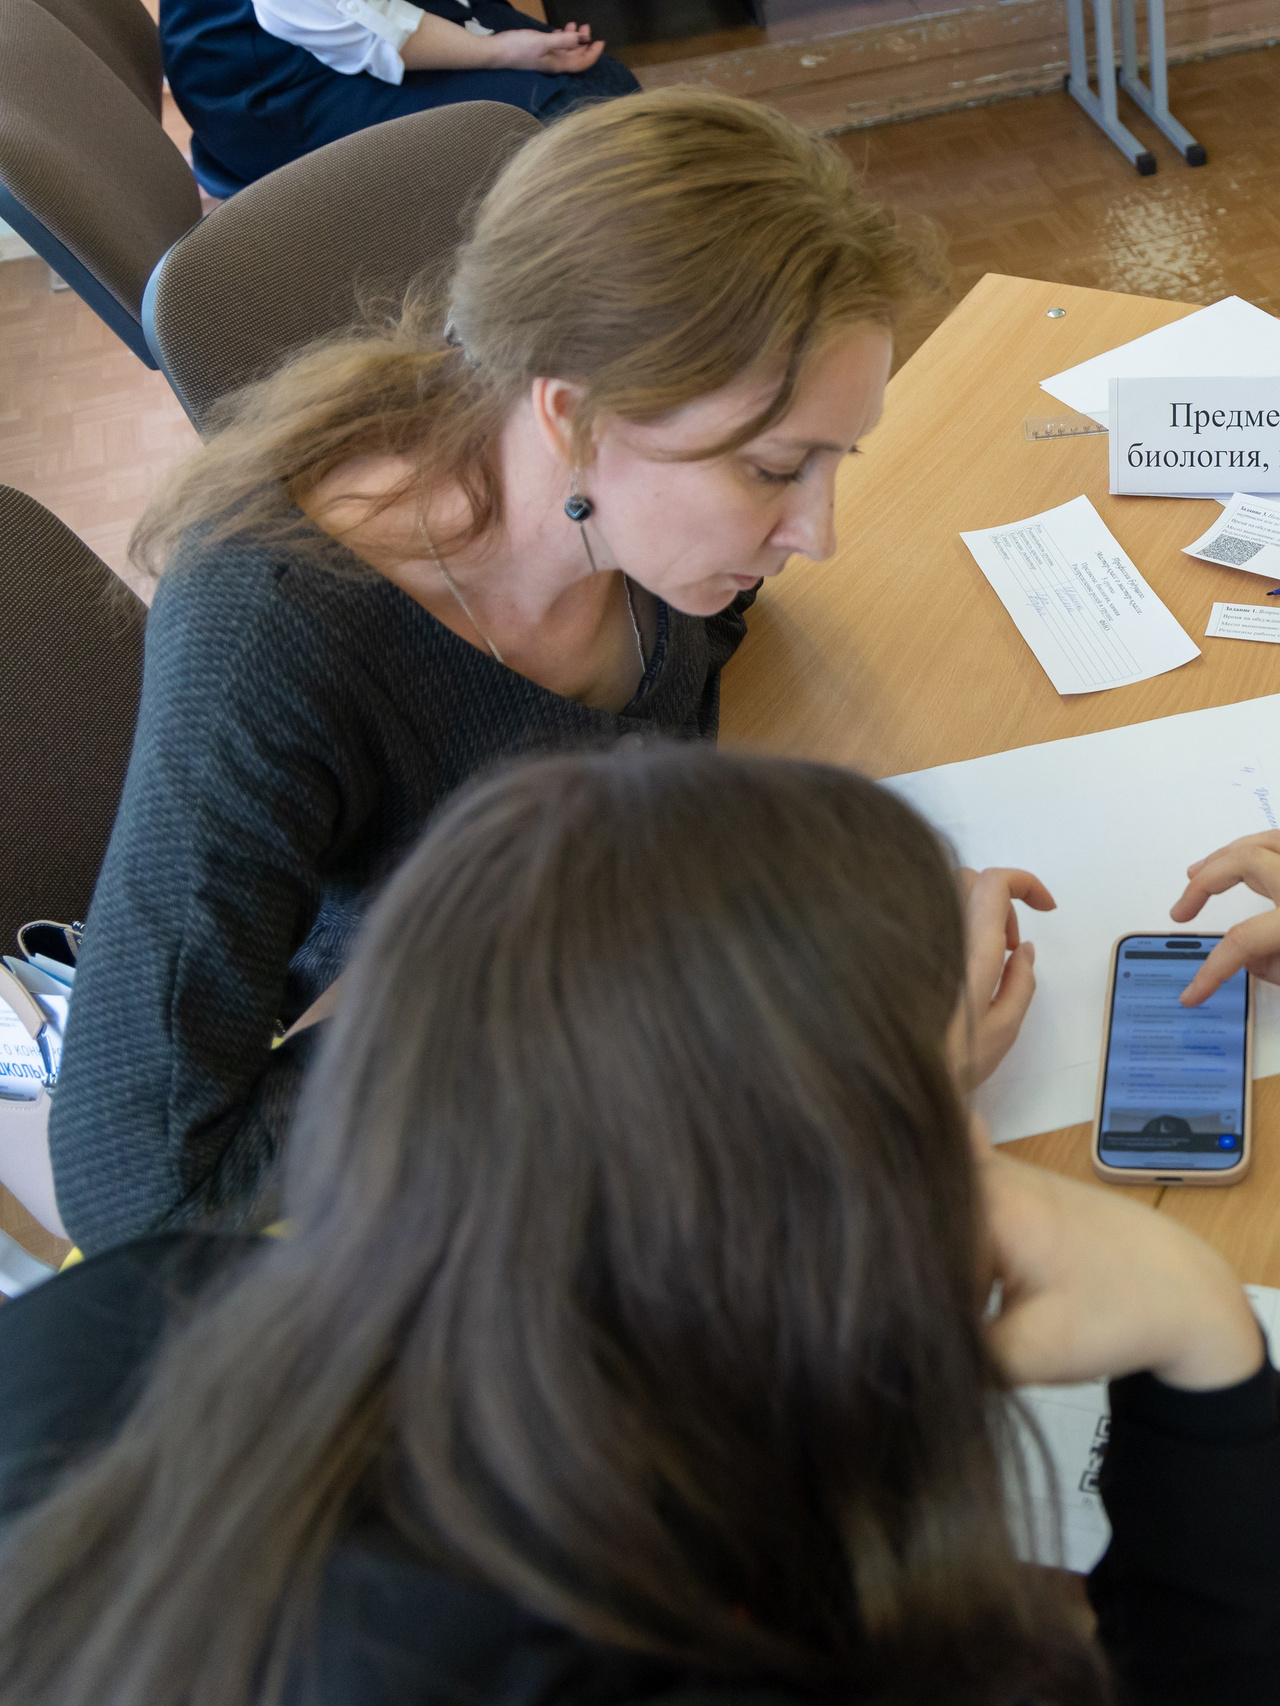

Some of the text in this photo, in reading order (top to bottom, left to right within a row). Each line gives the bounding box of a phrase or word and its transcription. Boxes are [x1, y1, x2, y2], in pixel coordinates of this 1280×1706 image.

[1127, 442, 1270, 473] биология,
[1231, 518, 1248, 527] Время
[1226, 524, 1243, 533] Место
[1223, 614, 1243, 622] Время
[1218, 627, 1253, 636] Результаты
